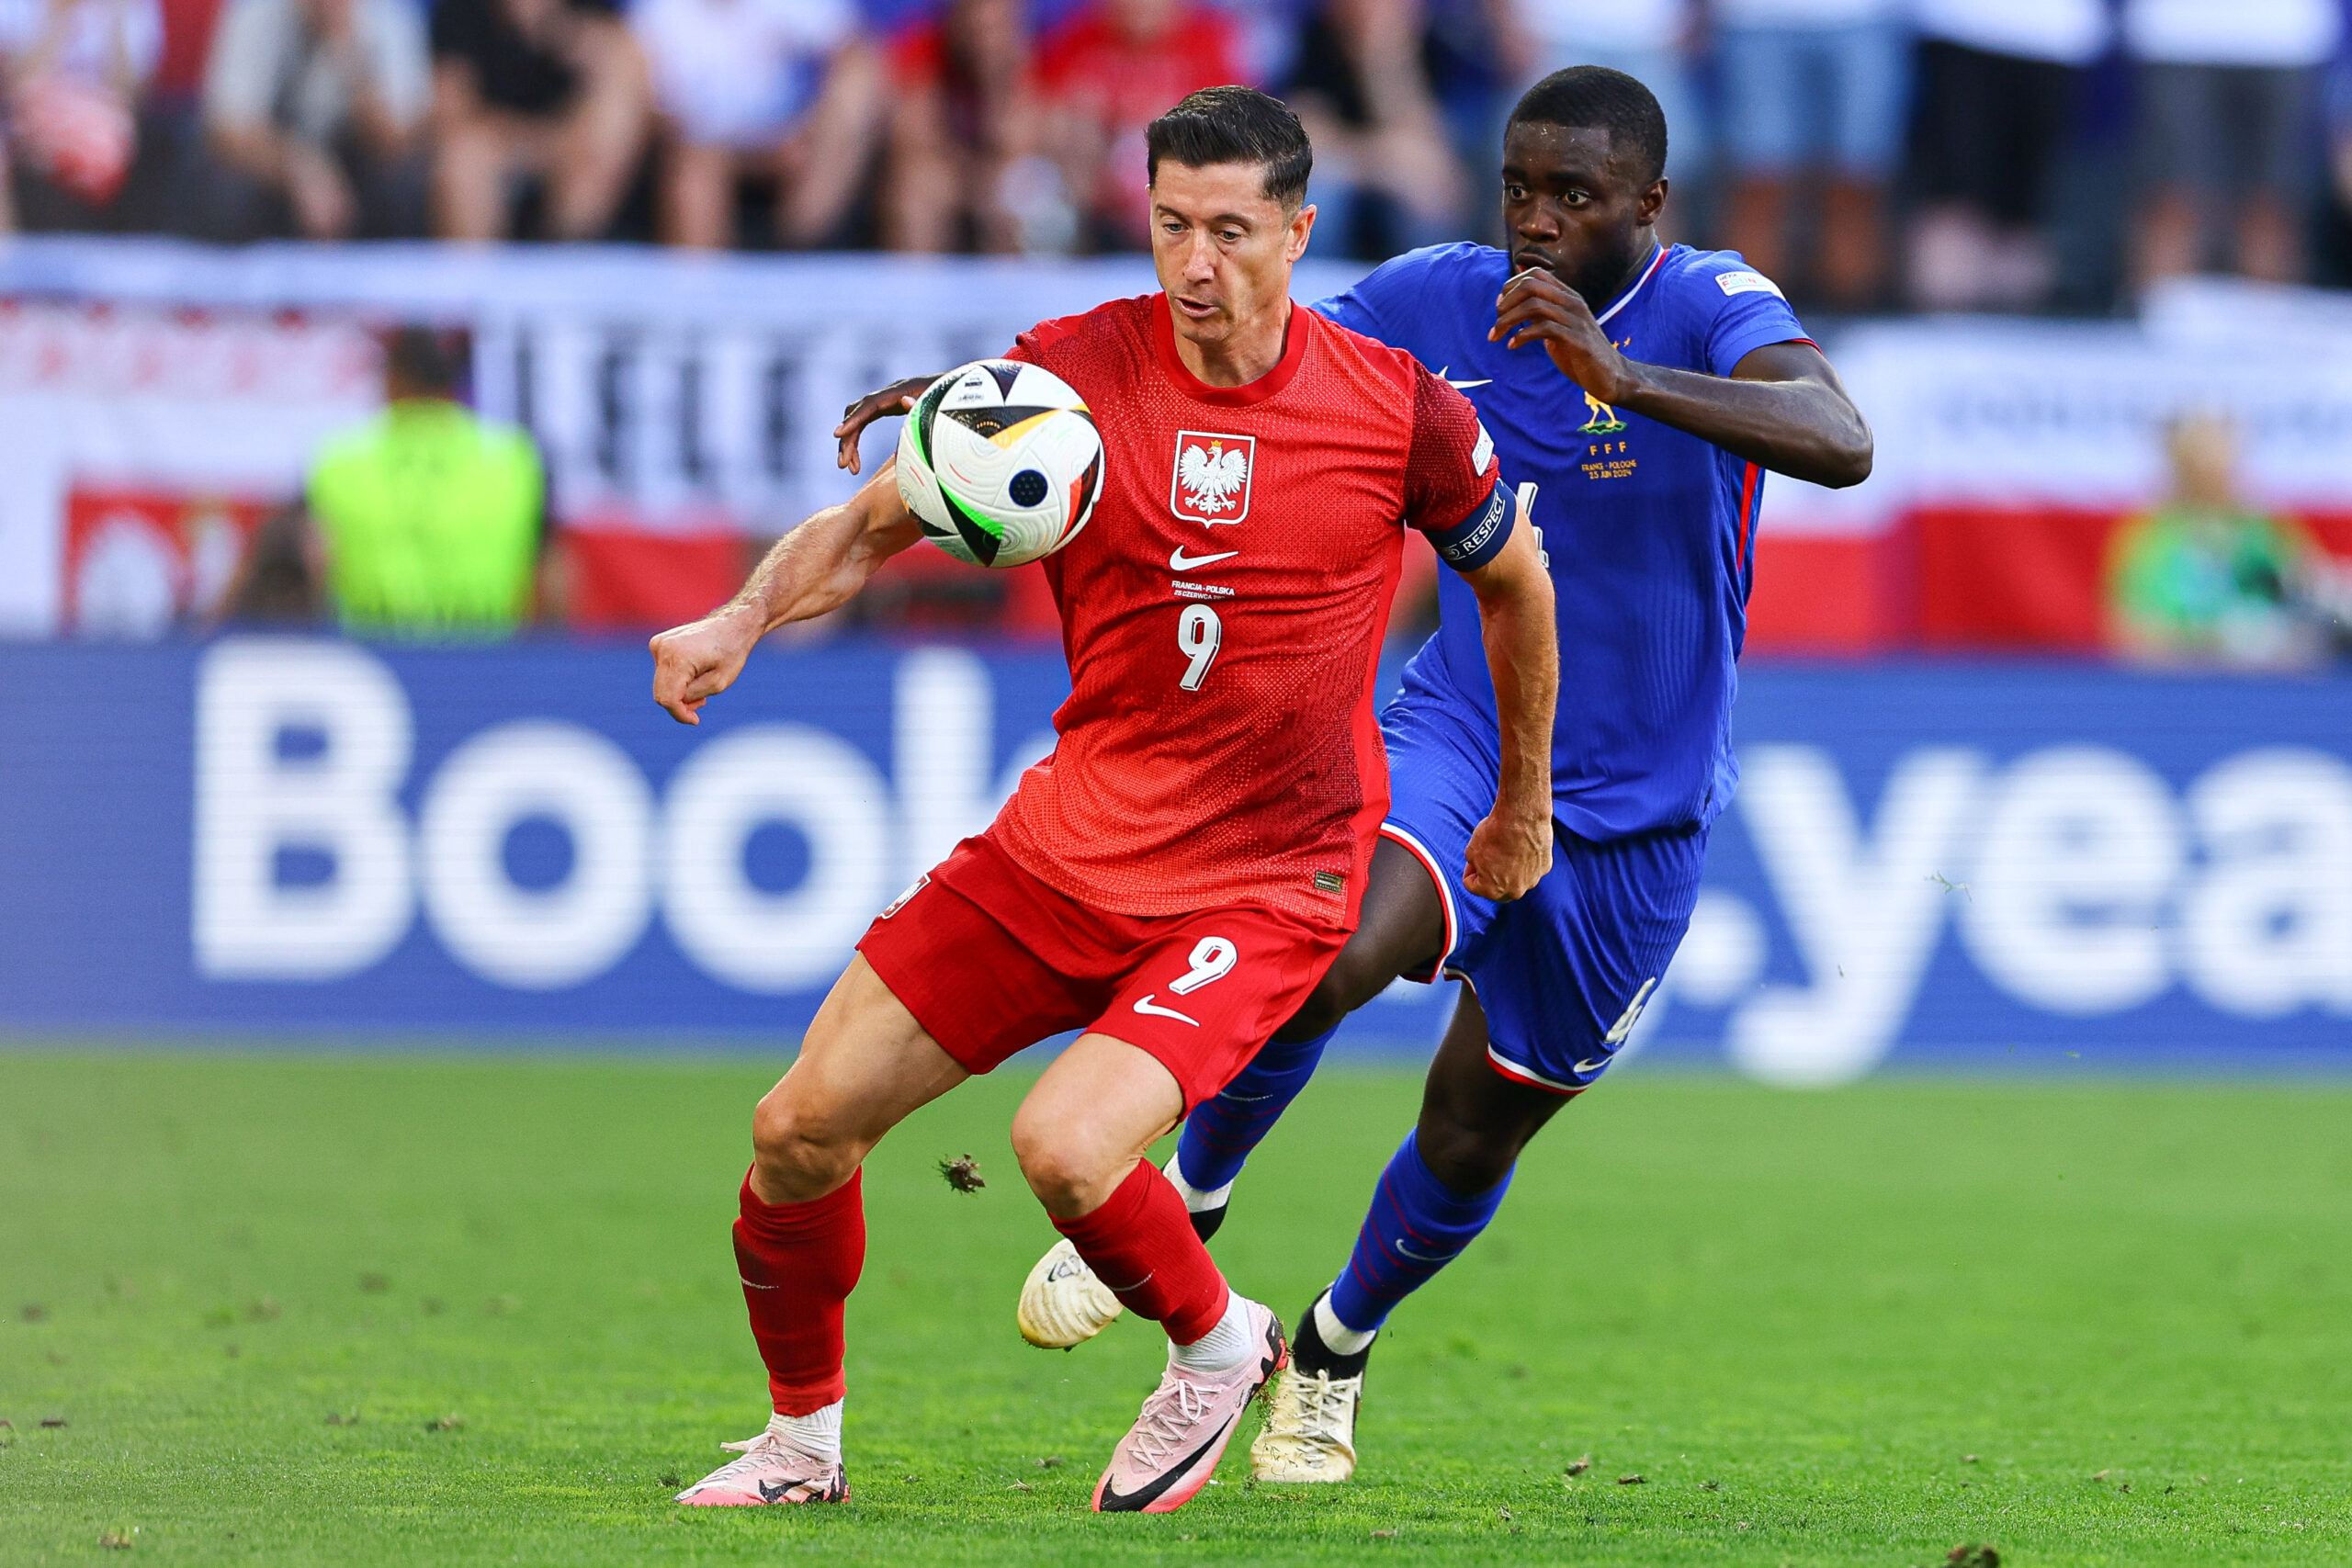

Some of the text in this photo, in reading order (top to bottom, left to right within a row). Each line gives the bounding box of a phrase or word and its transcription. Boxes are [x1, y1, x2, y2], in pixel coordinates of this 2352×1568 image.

[1589, 441, 1627, 456] F F F
[1589, 470, 1600, 479] 25
[1462, 493, 1504, 552] RESPECT
[1182, 591, 1213, 600] CZERWCA
[1178, 604, 1222, 691] 9
[1168, 935, 1238, 996] 9
